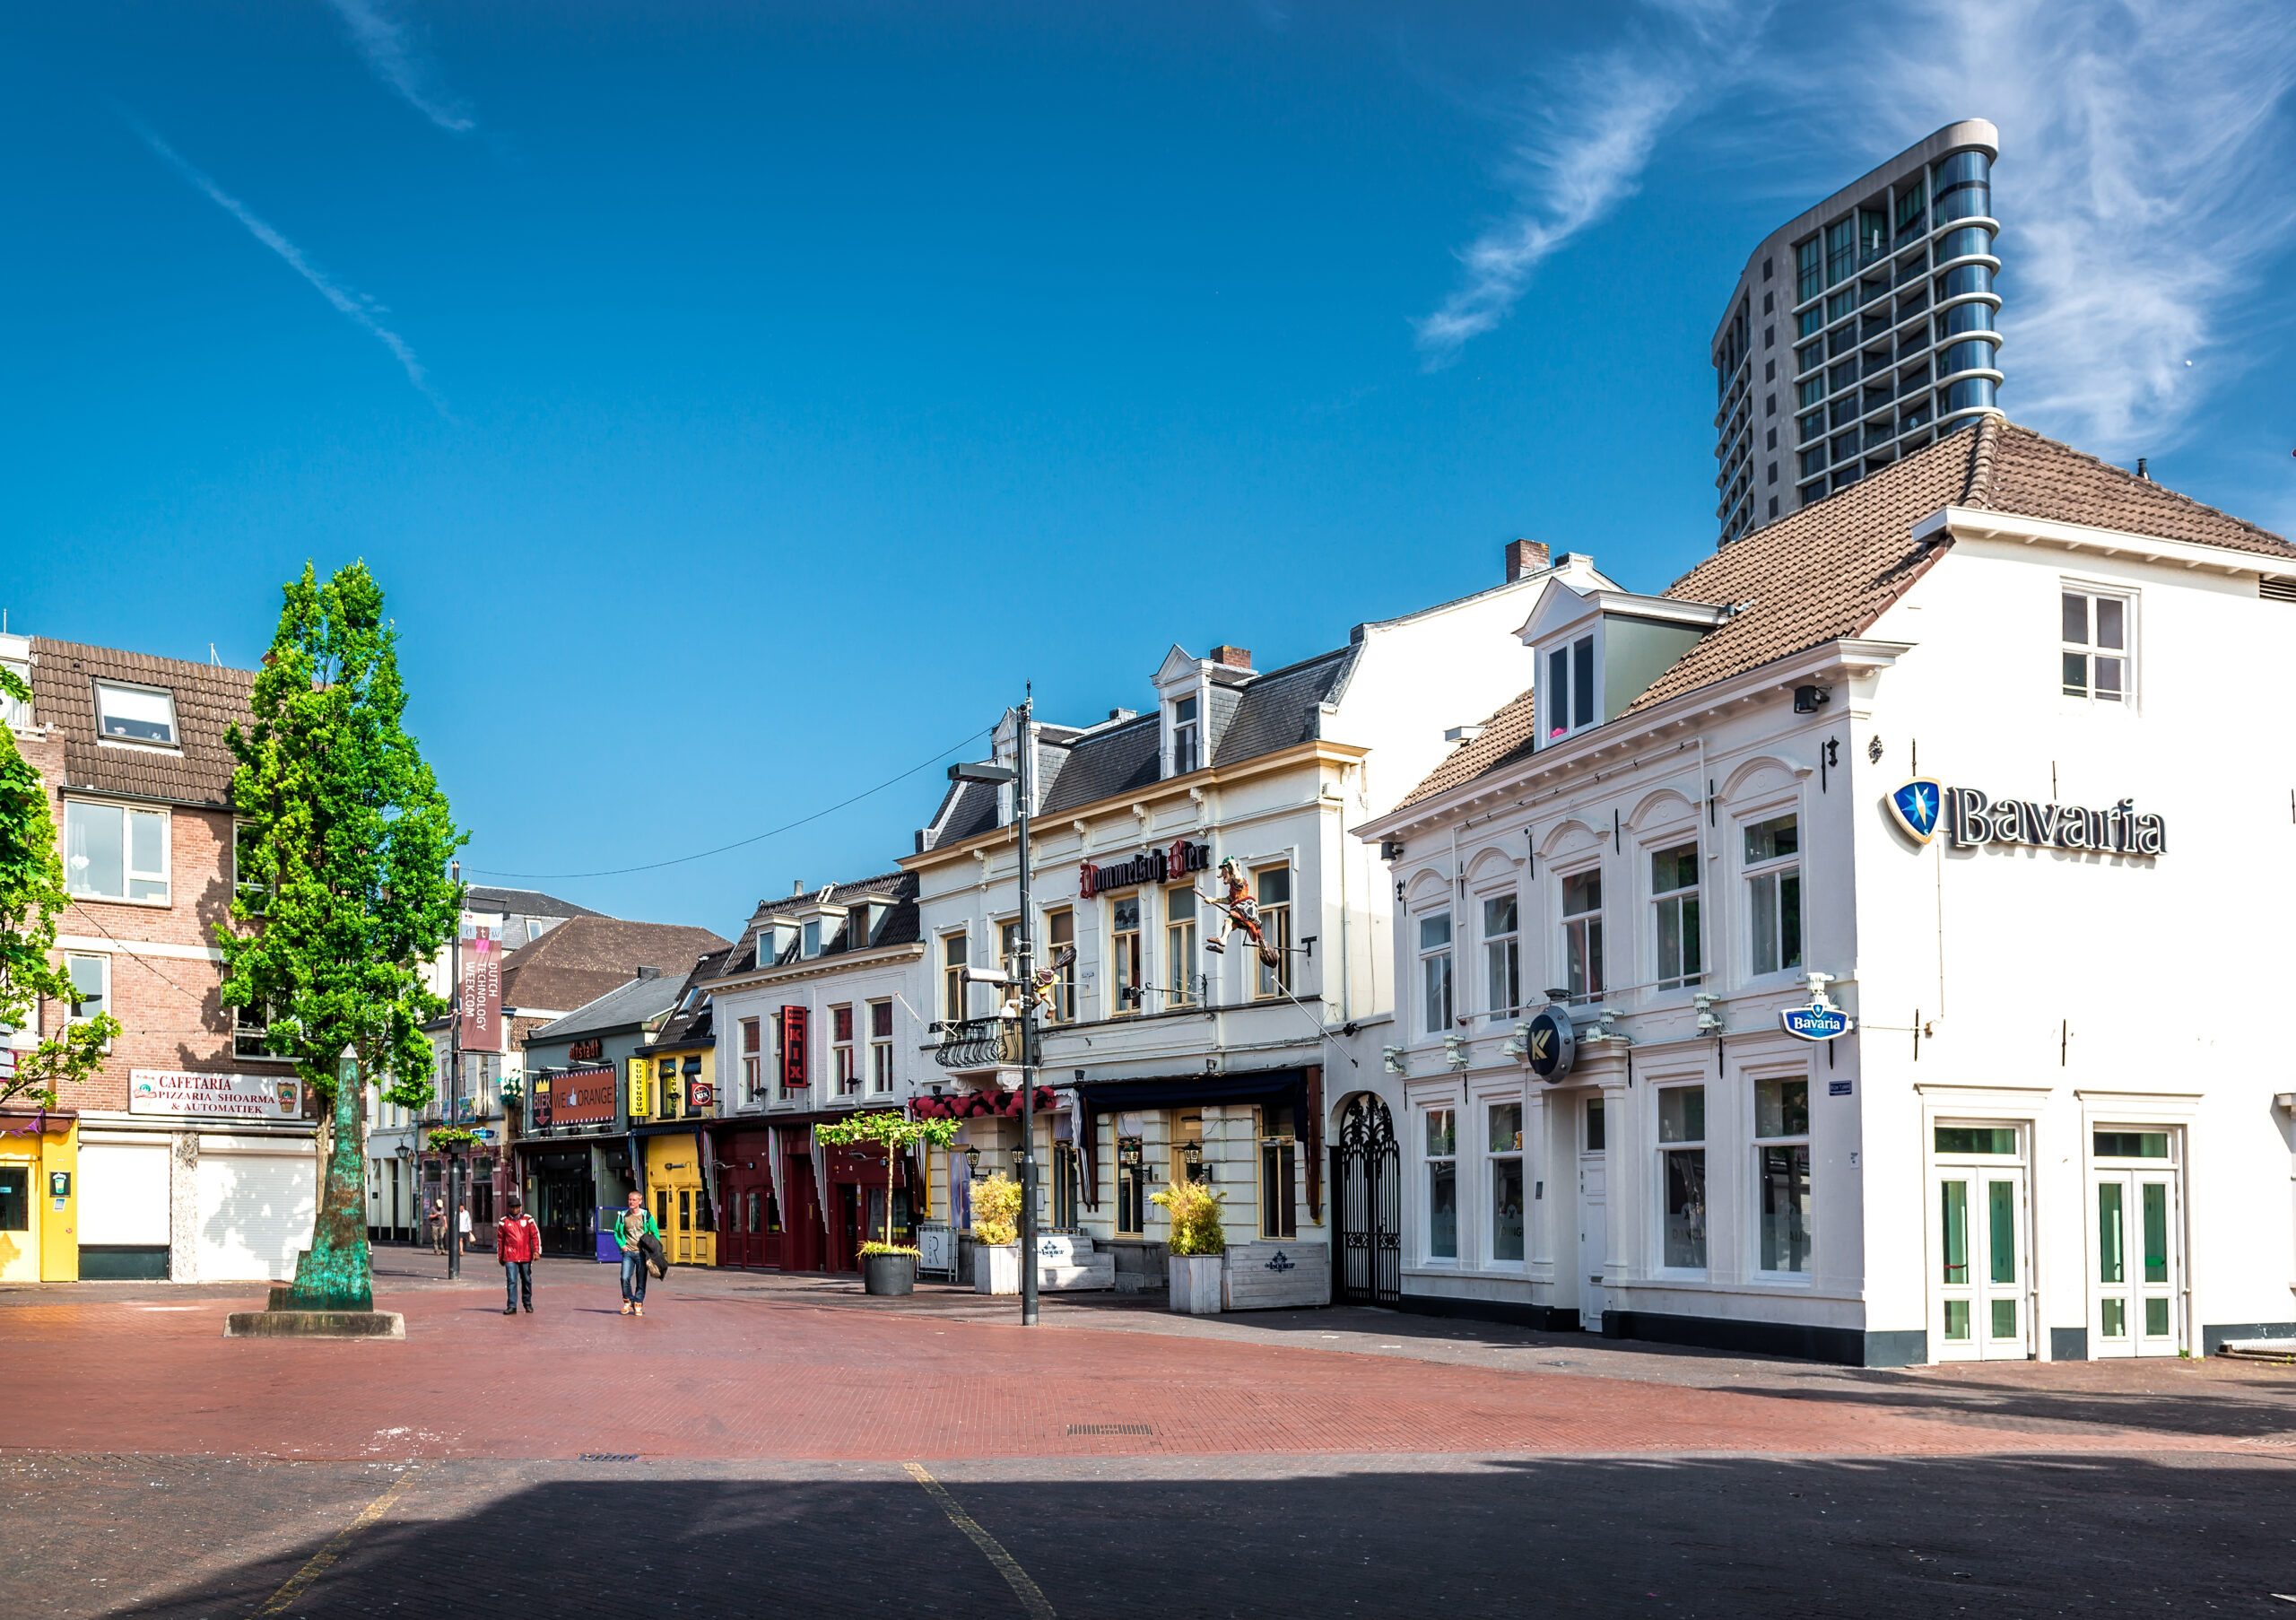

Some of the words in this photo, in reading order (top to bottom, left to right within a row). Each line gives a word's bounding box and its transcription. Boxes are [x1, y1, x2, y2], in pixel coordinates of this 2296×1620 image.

[1947, 786, 2168, 854] Bavaria
[1080, 849, 1167, 899] Dommelsch
[1168, 840, 1210, 879] Bier
[465, 962, 475, 1017] WEEK.COM
[488, 962, 498, 997] DUTCH
[476, 962, 487, 1031] TECHNOLOGY
[1794, 1017, 1841, 1031] Bavaria
[789, 1028, 802, 1079] KIX
[158, 1091, 212, 1102] PIZZARIA
[217, 1093, 275, 1104] SHOARMA
[159, 1076, 232, 1091] CAFETARIA
[553, 1093, 566, 1109] WE
[577, 1086, 613, 1107] ORANGE
[171, 1102, 180, 1110] &
[184, 1102, 263, 1114] AUTOMATIEK
[534, 1093, 551, 1110] BIER
